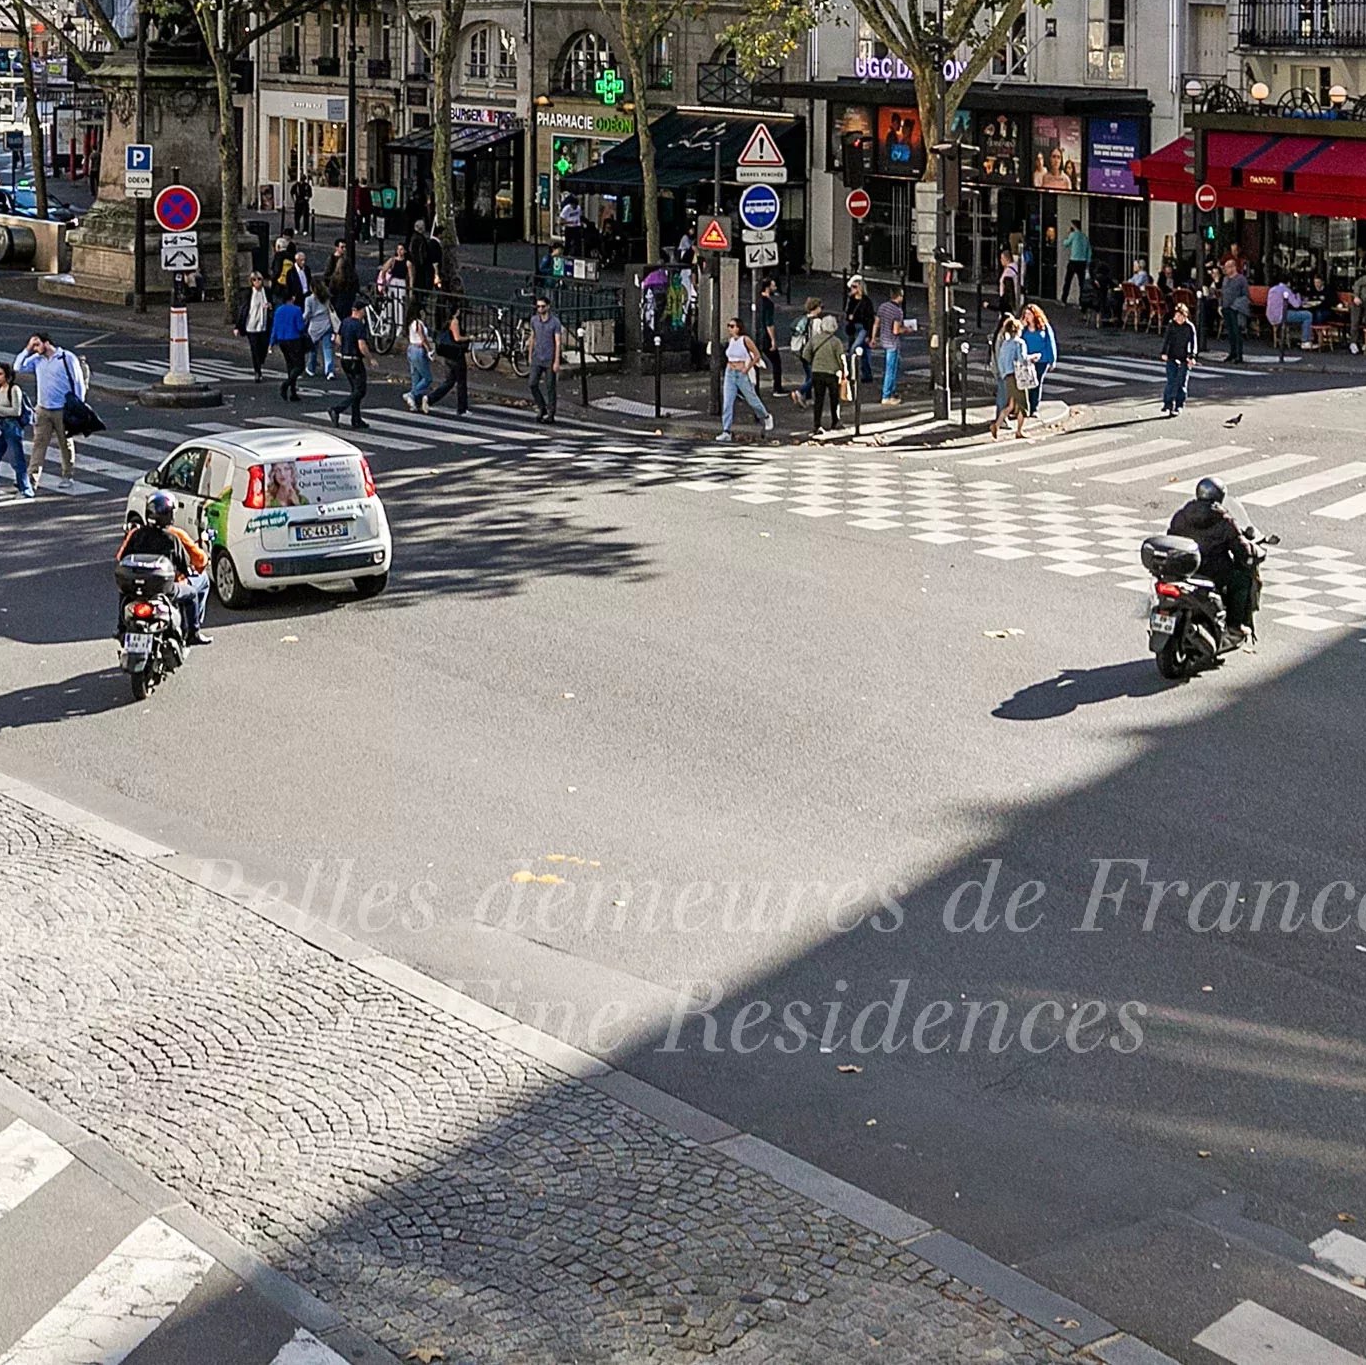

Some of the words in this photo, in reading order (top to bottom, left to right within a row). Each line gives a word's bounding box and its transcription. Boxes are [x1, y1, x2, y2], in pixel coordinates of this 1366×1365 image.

[855, 57, 892, 78] UGC
[896, 59, 967, 81] DON
[536, 112, 594, 130] PHARMACIE
[595, 115, 634, 133] ODÉON
[1250, 175, 1276, 185] DANTON
